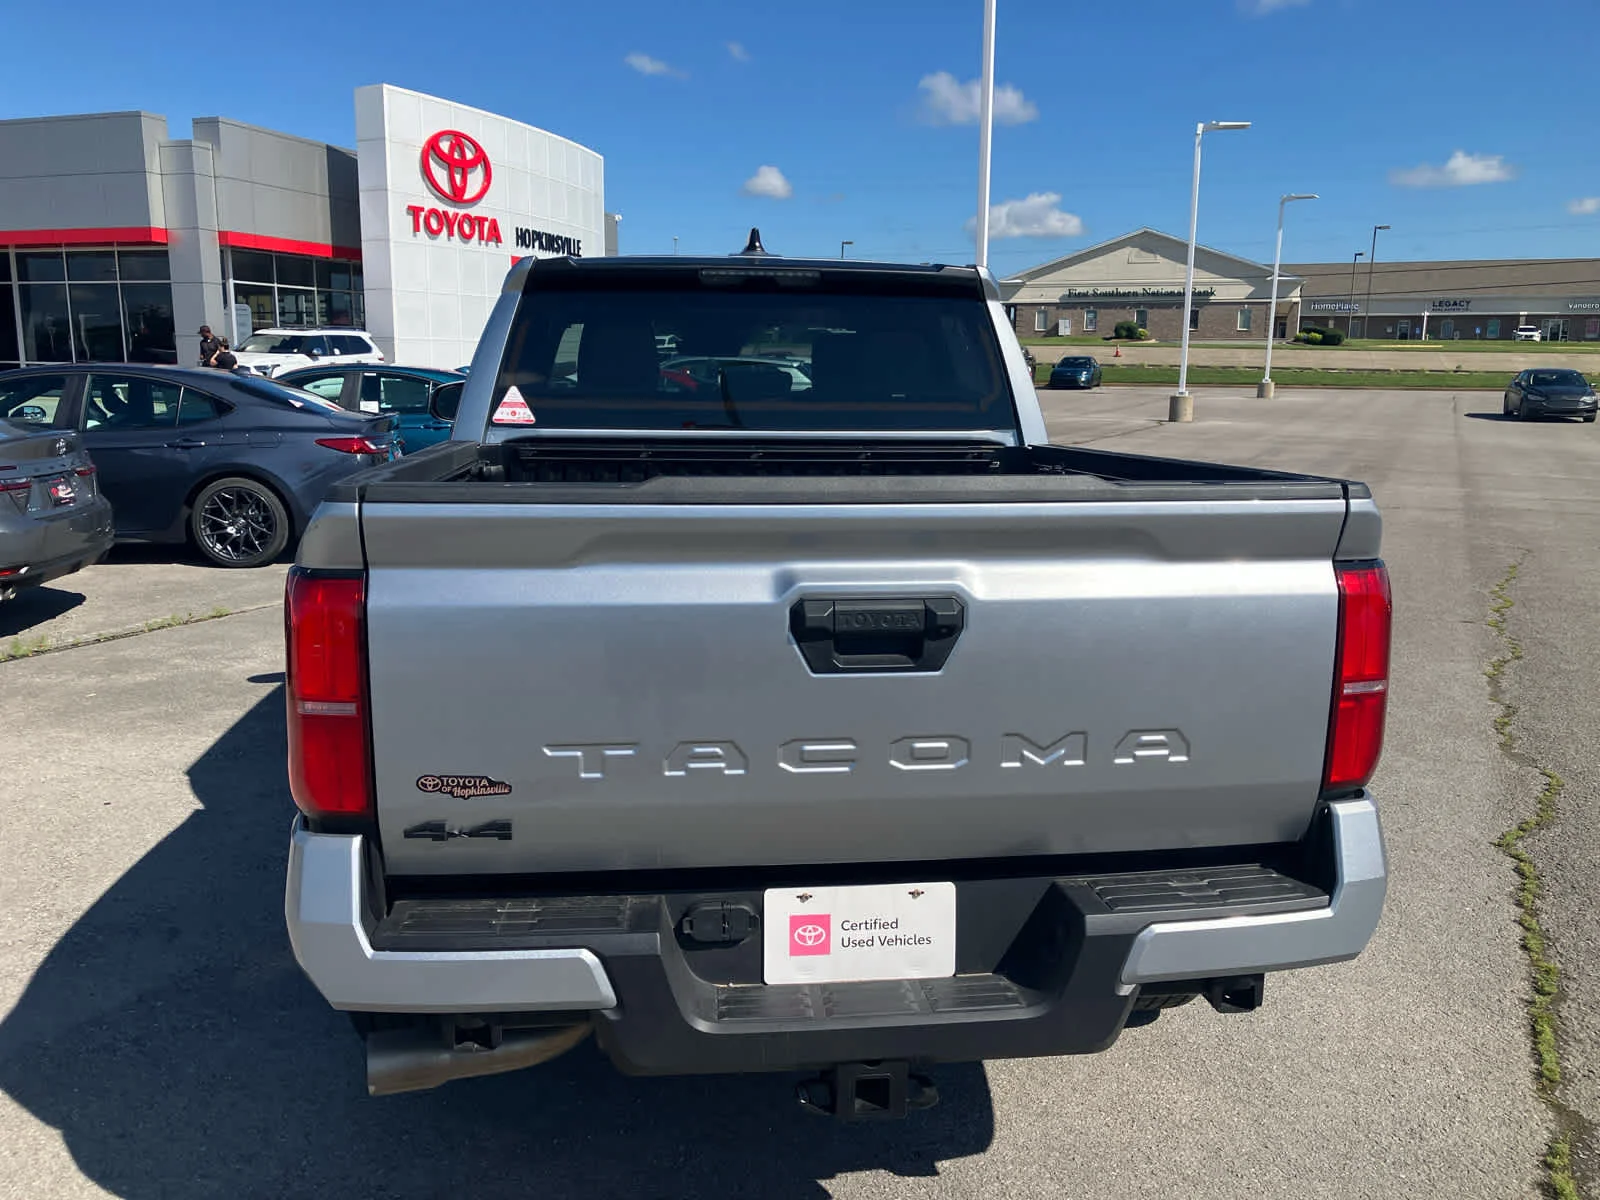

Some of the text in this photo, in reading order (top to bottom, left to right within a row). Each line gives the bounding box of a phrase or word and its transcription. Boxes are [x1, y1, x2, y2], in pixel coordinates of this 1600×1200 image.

[407, 205, 503, 246] TOYOTA
[515, 227, 582, 257] HOPKINSVILLE
[1068, 288, 1089, 297] First
[1092, 287, 1139, 297] Southern
[1142, 287, 1187, 297] National
[1311, 301, 1360, 310] HomePlace
[1432, 300, 1471, 308] LEGACY
[838, 611, 920, 628] TOYOTA
[542, 728, 1190, 779] TACOMA
[441, 777, 489, 786] TOYOTA
[453, 784, 510, 798] Hopkinsville
[841, 918, 899, 931] Certified
[841, 935, 932, 948] Used Vehicles
